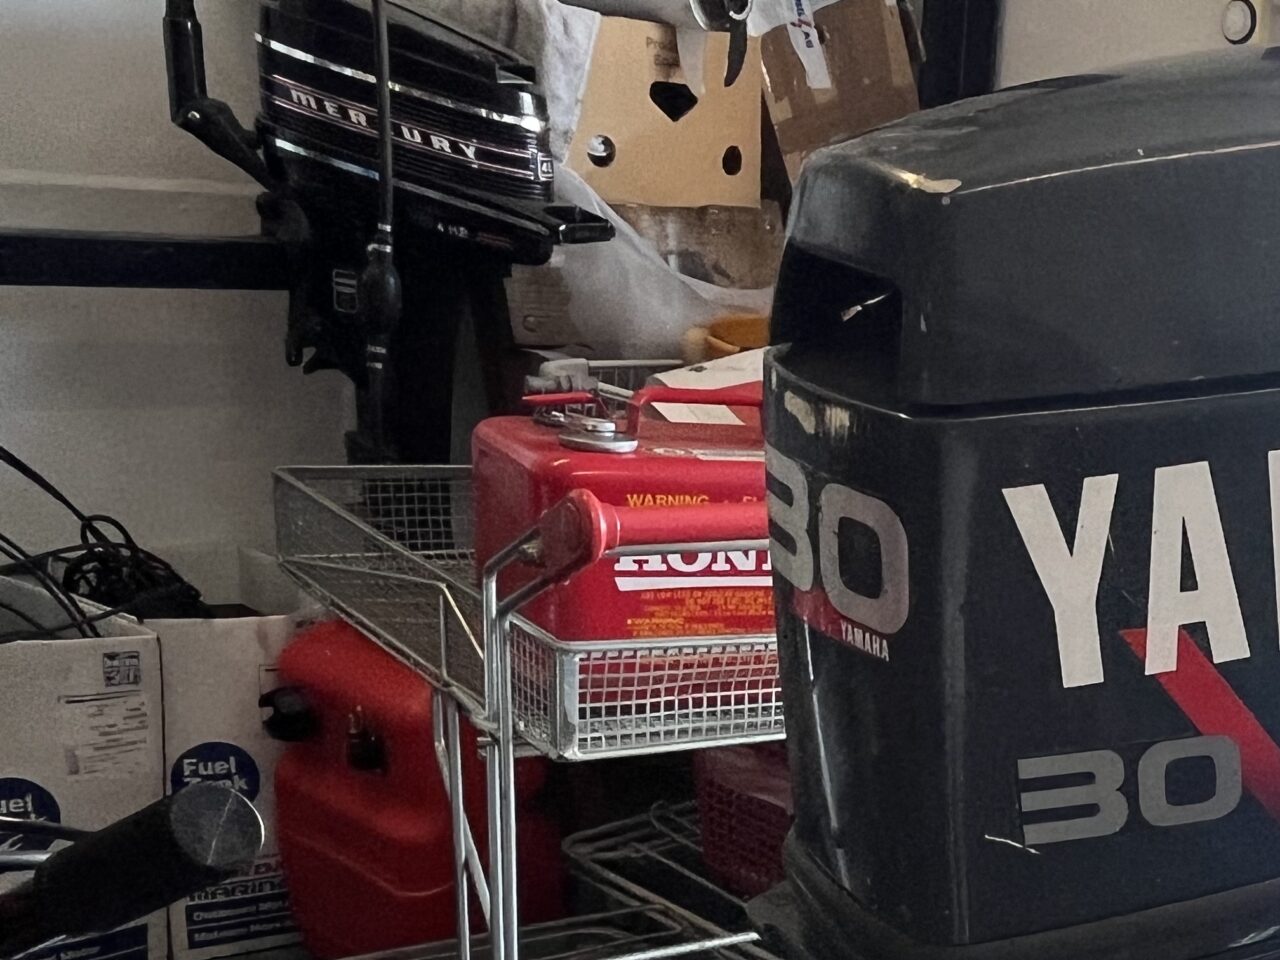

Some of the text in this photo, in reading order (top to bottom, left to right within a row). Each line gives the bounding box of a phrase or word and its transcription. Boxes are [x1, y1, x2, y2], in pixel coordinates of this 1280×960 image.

[290, 88, 476, 160] MERURY
[626, 493, 709, 508] WARNING
[840, 618, 890, 662] YAMAHA
[183, 755, 236, 776] Fuel
[1016, 734, 1243, 846] 30
